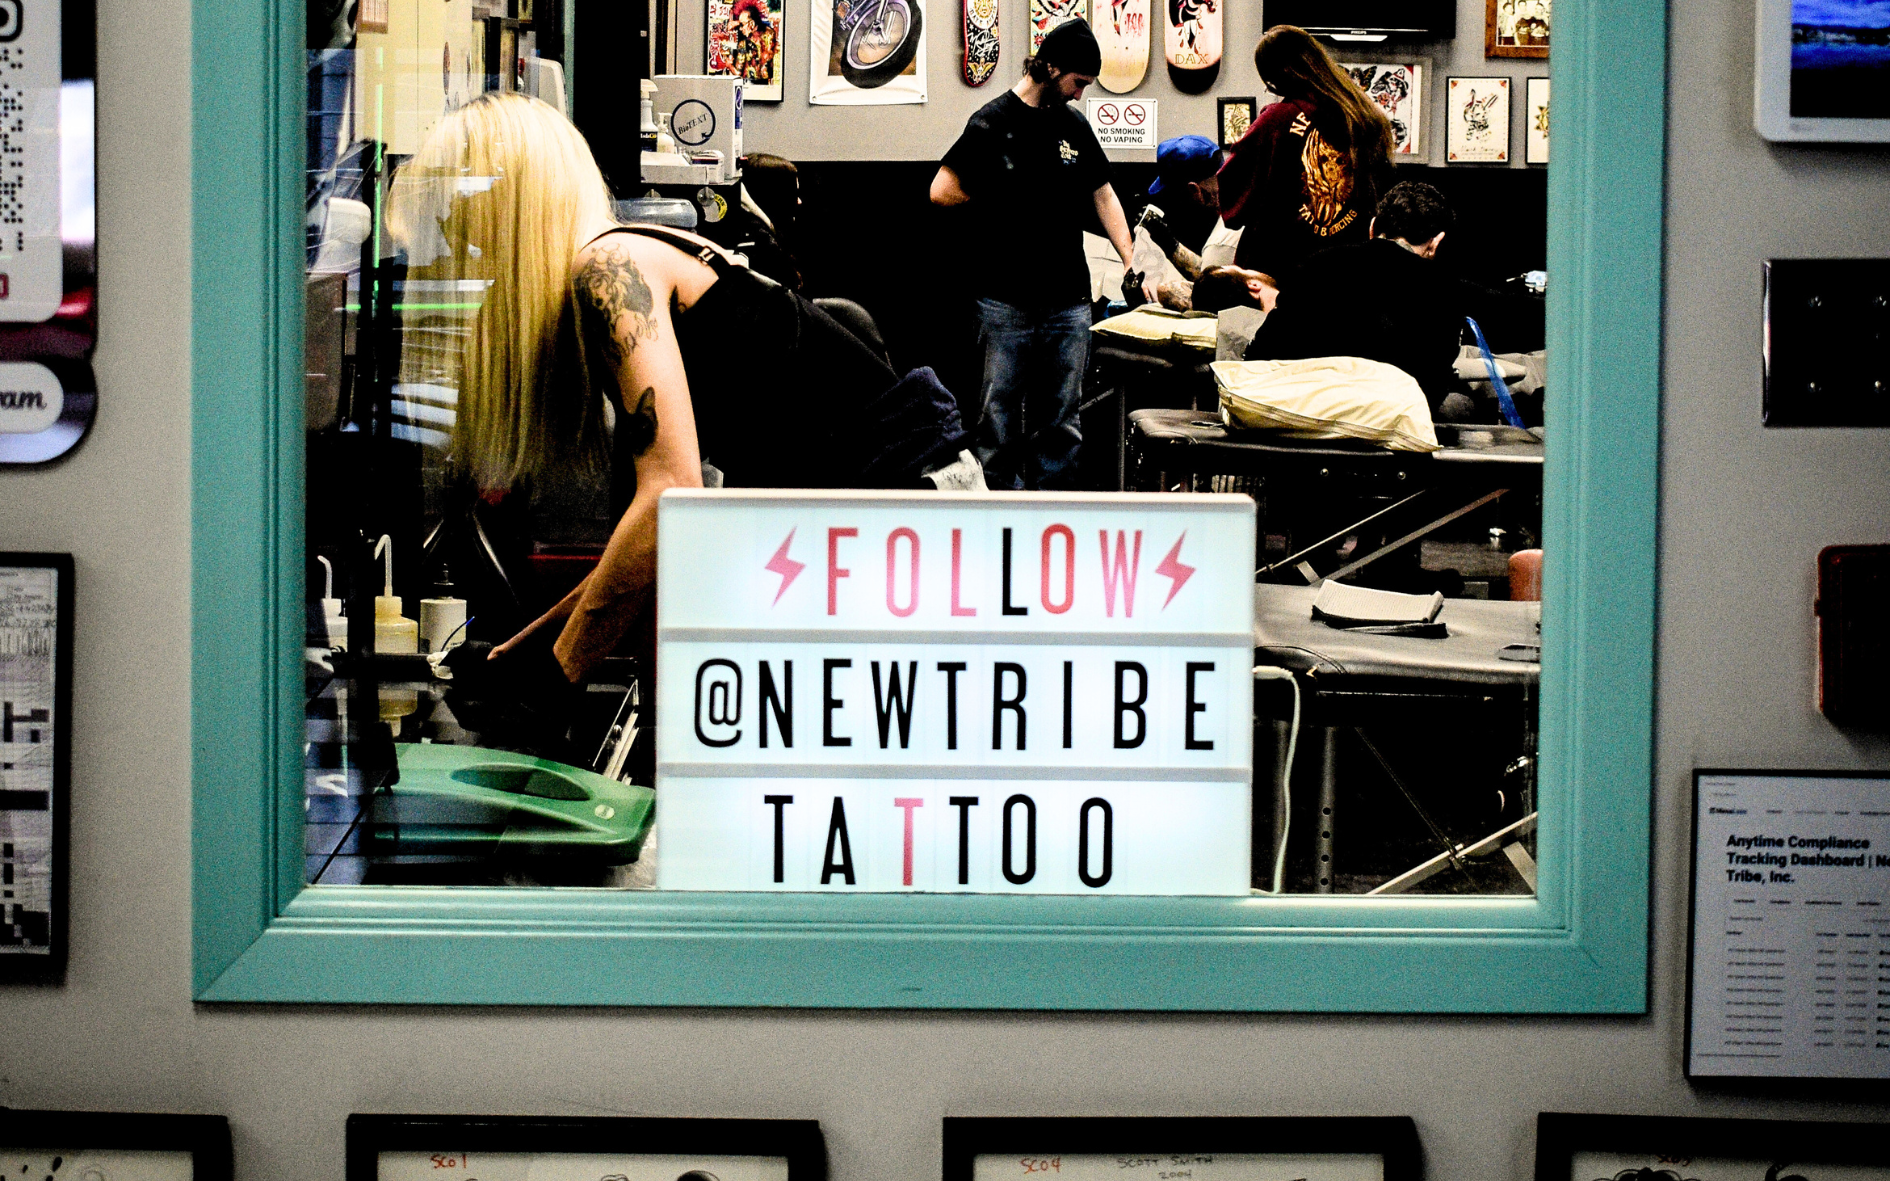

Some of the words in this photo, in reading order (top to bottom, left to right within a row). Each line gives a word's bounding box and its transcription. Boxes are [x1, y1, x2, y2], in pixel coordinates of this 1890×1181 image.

[1175, 53, 1209, 64] DAX
[1097, 127, 1109, 135] NO
[1110, 127, 1146, 135] SMOKING
[1113, 136, 1143, 144] VAPING
[826, 522, 1143, 618] FOLLOW
[693, 657, 1216, 751] @NEWTRIBE
[763, 792, 1114, 889] TATTOO
[1726, 834, 1785, 850] Anytime
[1788, 835, 1871, 851] Compliance
[1726, 852, 1787, 868] Tracking
[1790, 853, 1865, 867] Dashboard
[1726, 869, 1766, 885] Tribe,
[1770, 870, 1795, 883] Inc.
